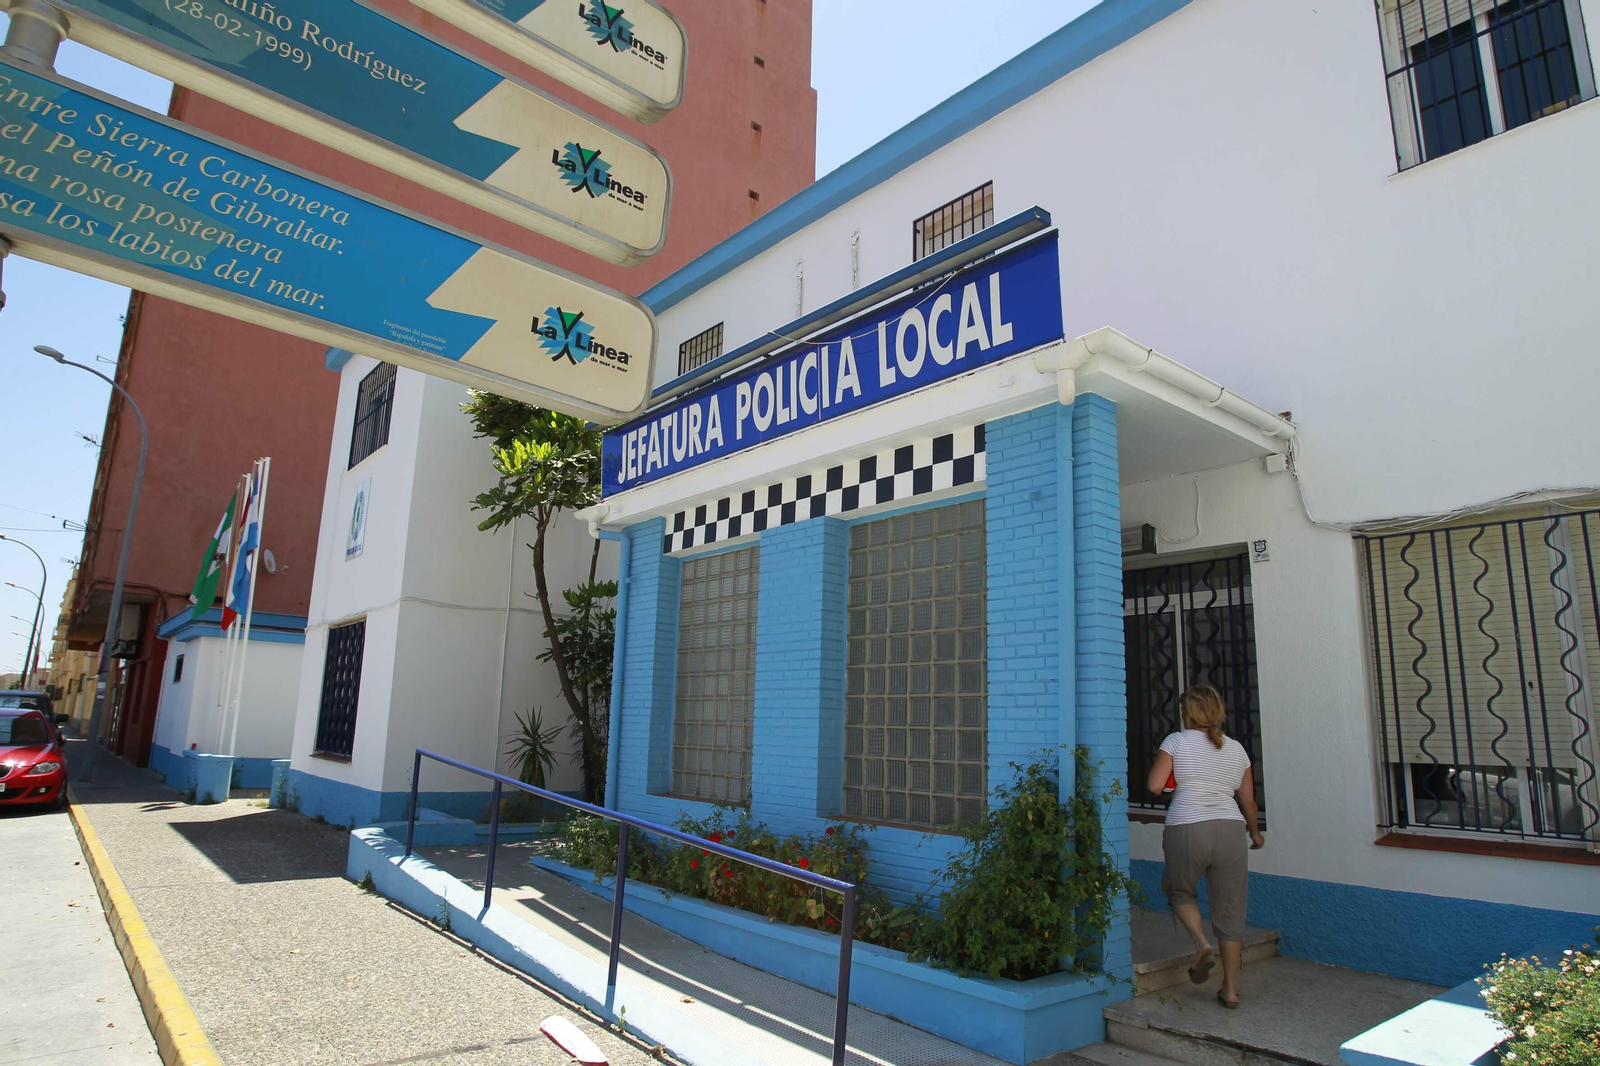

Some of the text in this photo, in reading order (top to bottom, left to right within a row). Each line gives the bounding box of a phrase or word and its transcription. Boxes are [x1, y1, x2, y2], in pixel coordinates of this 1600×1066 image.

[164, 0, 313, 71] (28-02-1999)
[300, 19, 427, 95] Rodríguez
[579, 2, 666, 65] La Línea
[1, 122, 344, 255] el Peñón de Gibraltar.
[87, 113, 188, 167] Sierra
[199, 155, 350, 226] Carbonera
[551, 148, 645, 205] La Línea
[50, 174, 126, 211] rosa
[129, 202, 283, 264] postenera
[46, 202, 100, 237] los
[108, 221, 207, 272] labios
[214, 258, 263, 289] del
[267, 279, 326, 310] mar.
[382, 319, 412, 333] Fragmento
[530, 316, 629, 365] La Línea
[599, 360, 611, 368] mar
[616, 365, 628, 373] mar
[617, 271, 1015, 485] JEFATURA POLICIA LOCAL
